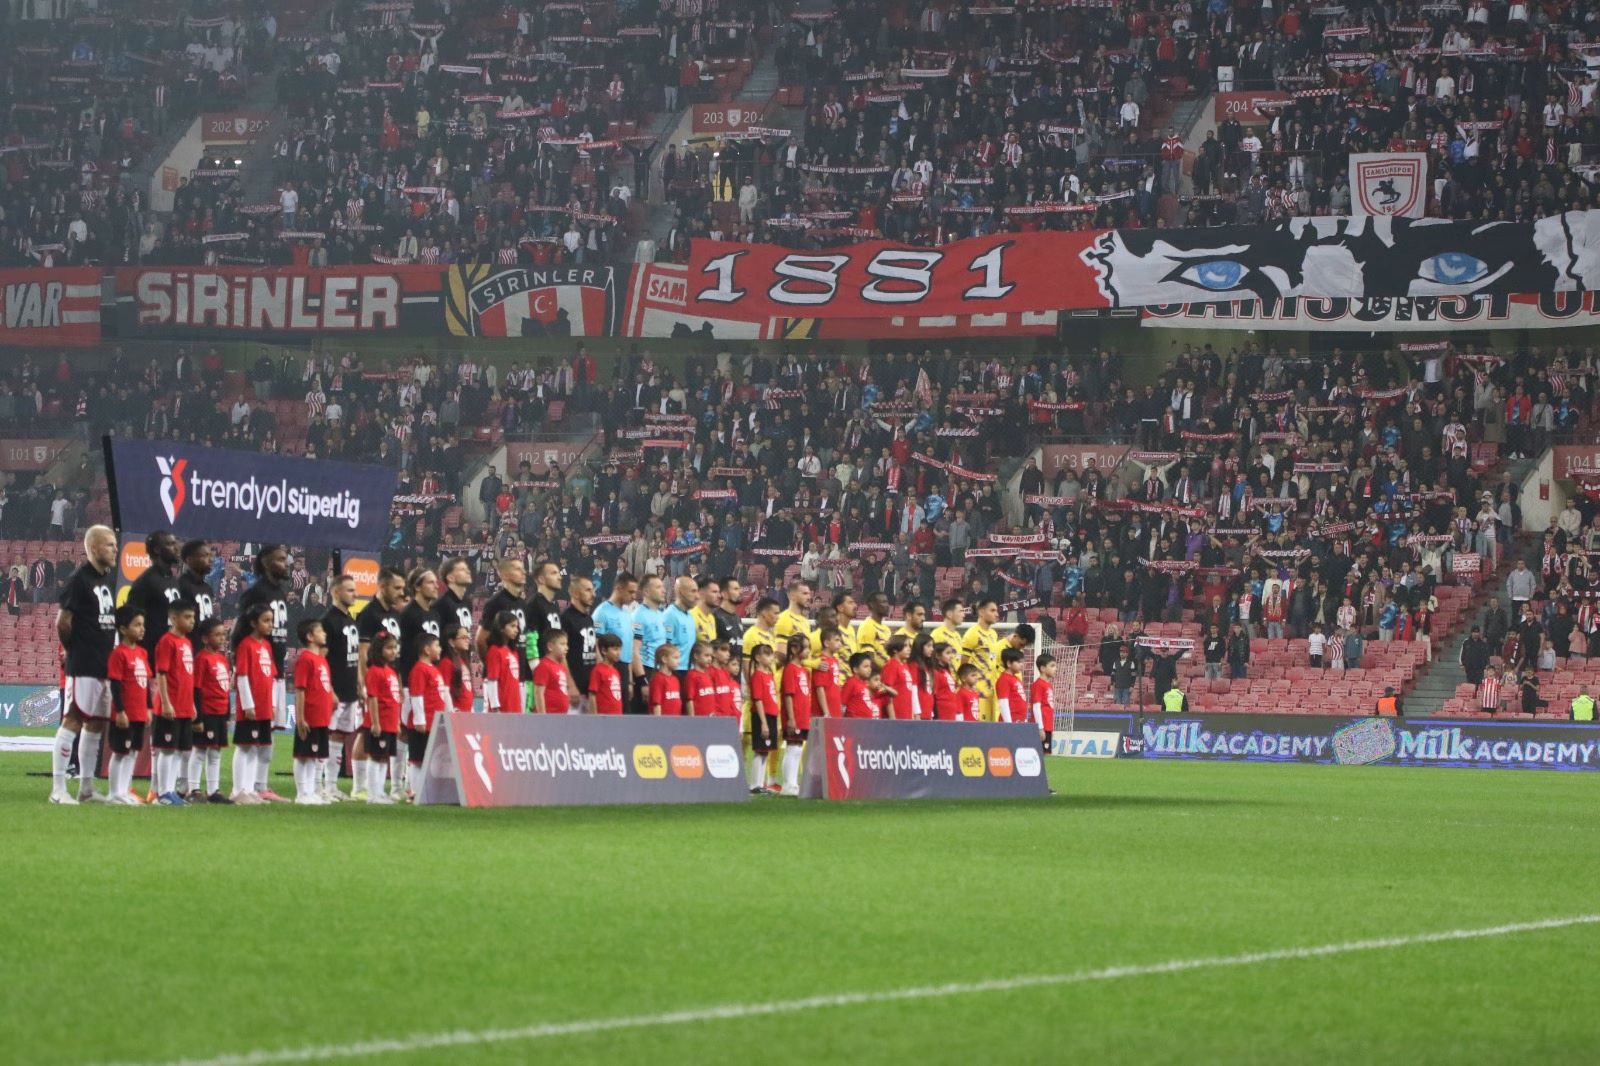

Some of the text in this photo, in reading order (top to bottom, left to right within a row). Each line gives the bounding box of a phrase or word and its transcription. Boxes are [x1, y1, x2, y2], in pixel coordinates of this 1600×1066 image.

[1226, 100, 1248, 112] 204
[703, 112, 724, 124] 203
[211, 121, 231, 133] 202
[1366, 167, 1411, 176] SAMSUNSPOR
[697, 245, 1014, 304] 1881
[6, 281, 62, 328] VAR
[1034, 402, 1079, 410] SAMSUNSPOR
[9, 449, 30, 460] 101
[1565, 456, 1590, 468] 104
[190, 470, 286, 520] trendyol
[1143, 721, 1211, 754] Milk
[1212, 734, 1329, 757] ACADEMY
[1397, 728, 1595, 763] Milk ACADEMY
[498, 742, 572, 777] trendyol
[673, 755, 701, 768] trendyol
[857, 744, 911, 775] trendyol
[990, 756, 1011, 768] trendyol
